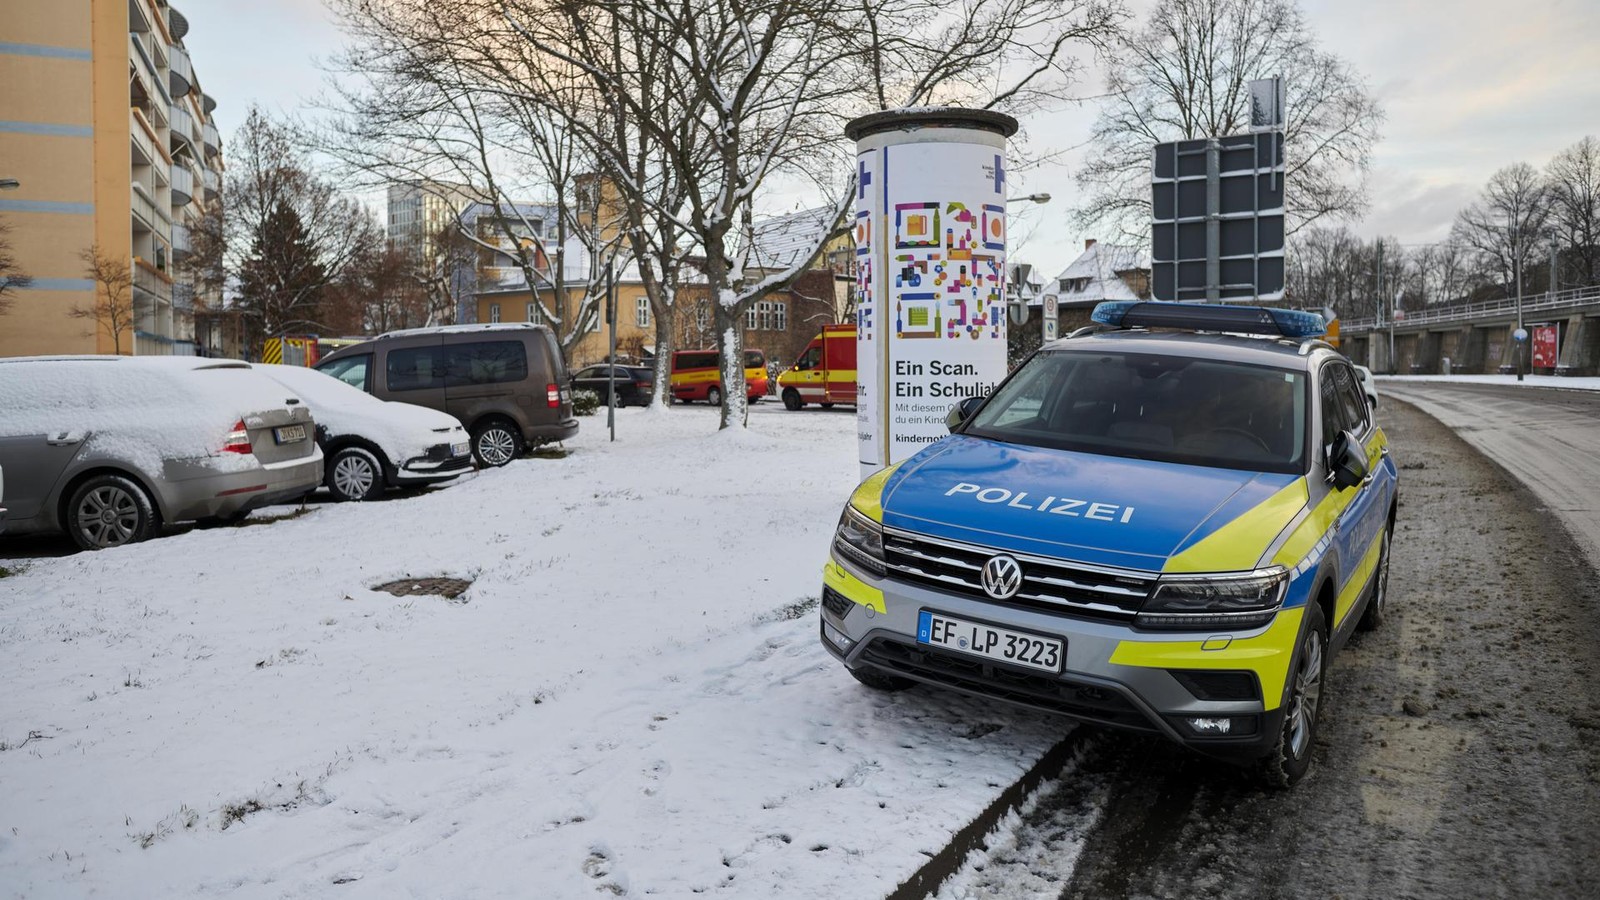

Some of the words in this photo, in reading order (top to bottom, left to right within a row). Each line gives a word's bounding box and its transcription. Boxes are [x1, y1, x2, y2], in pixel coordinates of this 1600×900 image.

[895, 360, 923, 376] Ein
[929, 360, 978, 376] Scan.
[895, 382, 923, 397] Ein
[895, 403, 909, 412] Mit
[911, 403, 946, 412] diesem
[895, 415, 906, 424] du
[908, 416, 922, 424] ein
[895, 433, 947, 443] kinderno
[944, 482, 1135, 524] POLIZEI
[921, 629, 927, 638] D
[930, 618, 958, 645] EF
[971, 627, 999, 654] LP
[1003, 633, 1059, 668] 3223
